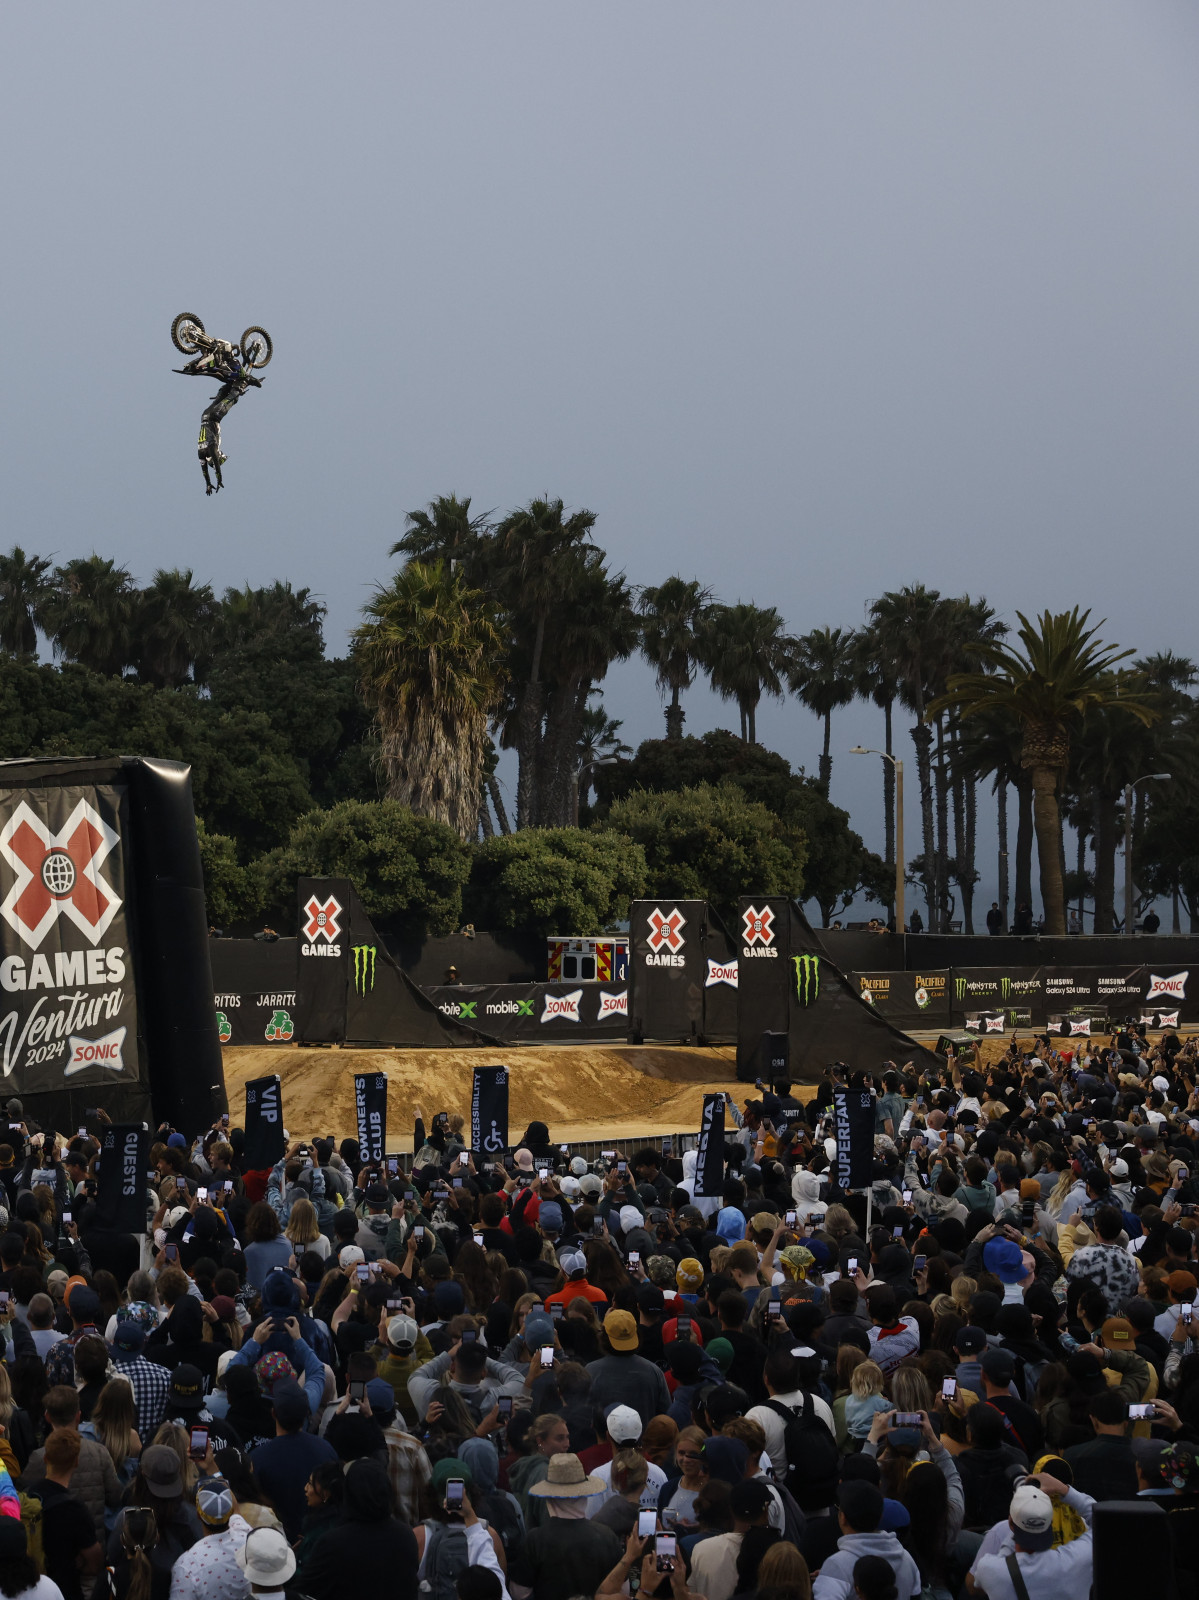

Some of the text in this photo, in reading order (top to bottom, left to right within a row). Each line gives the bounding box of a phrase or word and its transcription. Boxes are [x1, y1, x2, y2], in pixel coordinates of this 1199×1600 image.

[301, 944, 341, 957] GAMES
[743, 947, 778, 958] GAMES
[645, 954, 685, 967] GAMES
[0, 947, 125, 991] GAMES
[710, 967, 738, 980] SONIC
[967, 981, 998, 990] MONSTER
[1010, 980, 1041, 990] MONSTER
[1045, 987, 1065, 995] Galaxy
[1097, 986, 1117, 995] Galaxy
[1152, 981, 1183, 992] SONIC
[214, 995, 241, 1008] RITOS
[486, 1000, 535, 1016] mobileX
[547, 1001, 576, 1013] SONIC
[603, 998, 628, 1010] SONI
[438, 1002, 478, 1018] obileX
[25, 1040, 65, 1067] 2024
[73, 1042, 118, 1062] SONIC
[260, 1085, 278, 1123] VIP
[472, 1073, 481, 1153] ACCESSIBILITY
[355, 1077, 370, 1163] OWNER'S
[370, 1111, 383, 1162] CLUB
[835, 1093, 852, 1189] SUPERFAN
[122, 1132, 139, 1196] GUESTS
